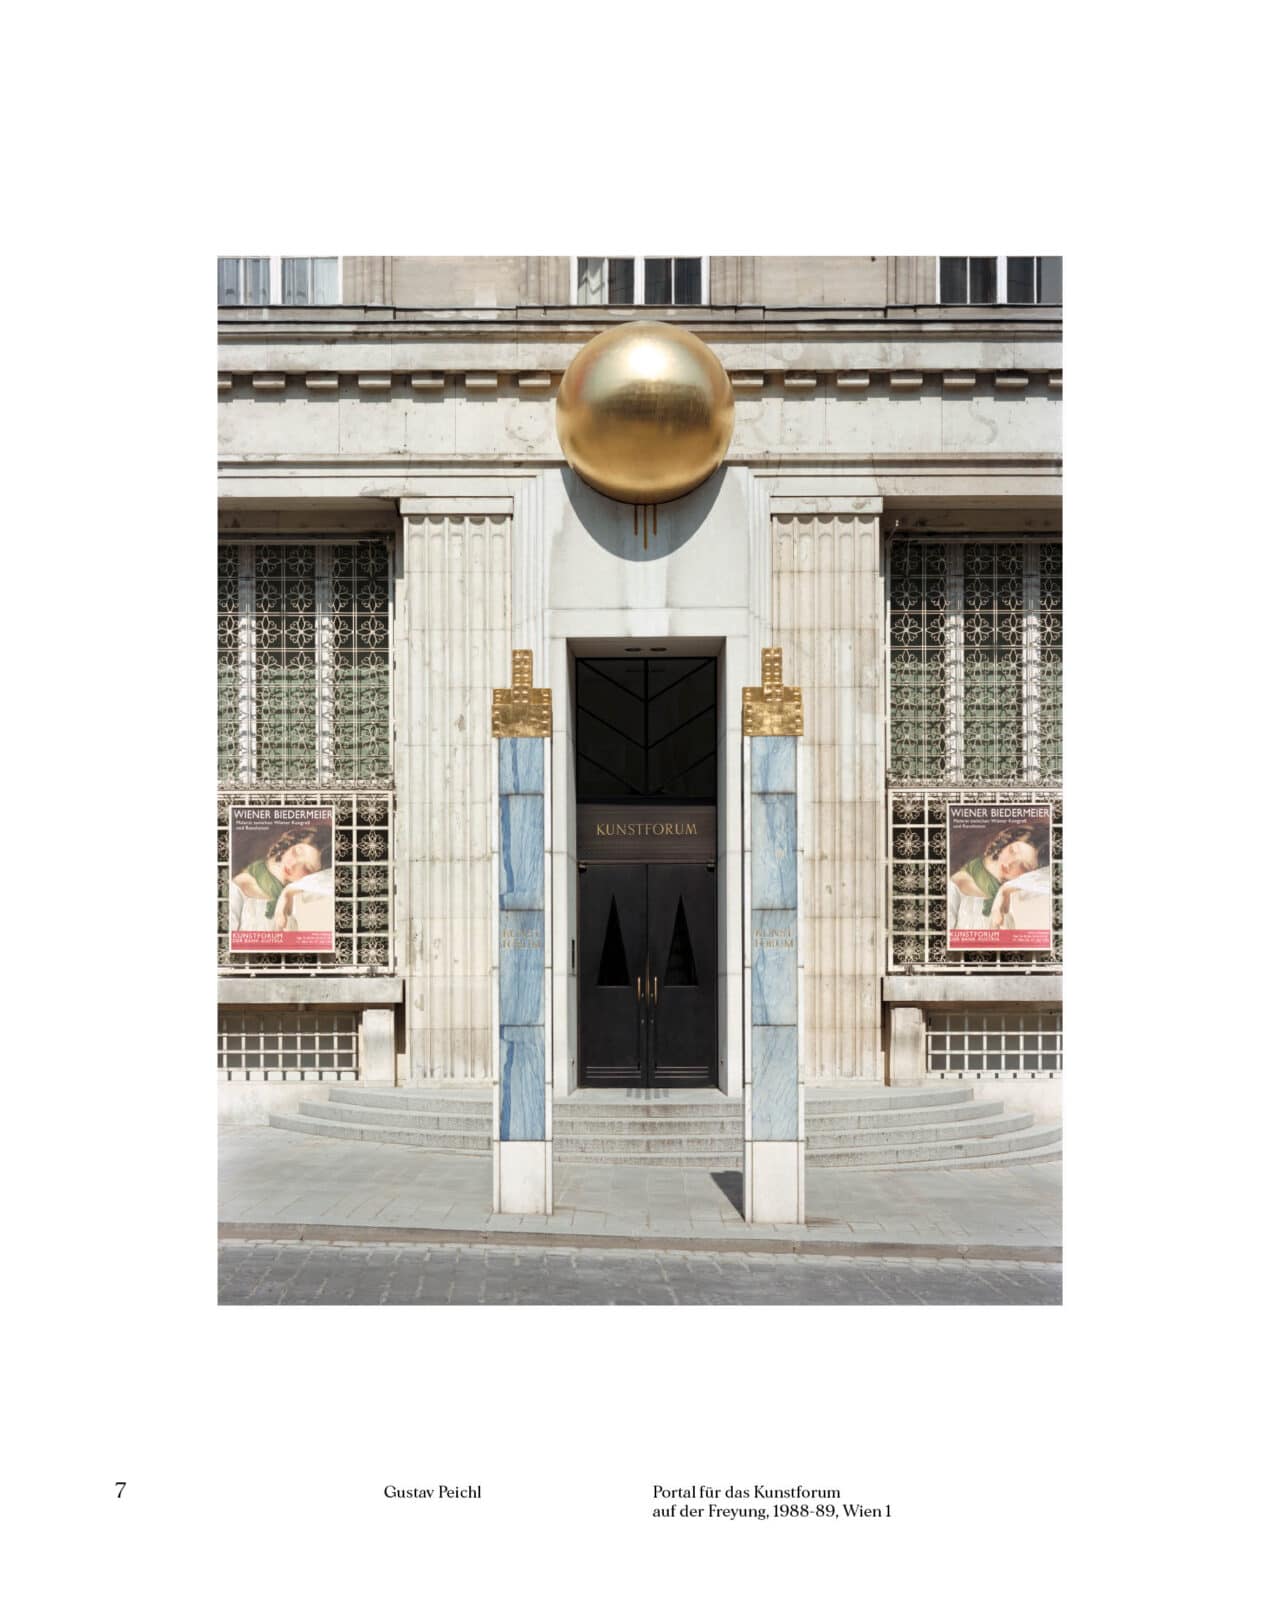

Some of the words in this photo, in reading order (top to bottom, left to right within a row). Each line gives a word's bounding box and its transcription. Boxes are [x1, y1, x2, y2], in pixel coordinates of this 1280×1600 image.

[234, 809, 271, 819] WIENER
[274, 809, 333, 819] BIEDERMEIER
[951, 808, 988, 818] WIENER
[990, 808, 1050, 818] BIEDERMEIER
[596, 823, 698, 836] KUNSTFORUM
